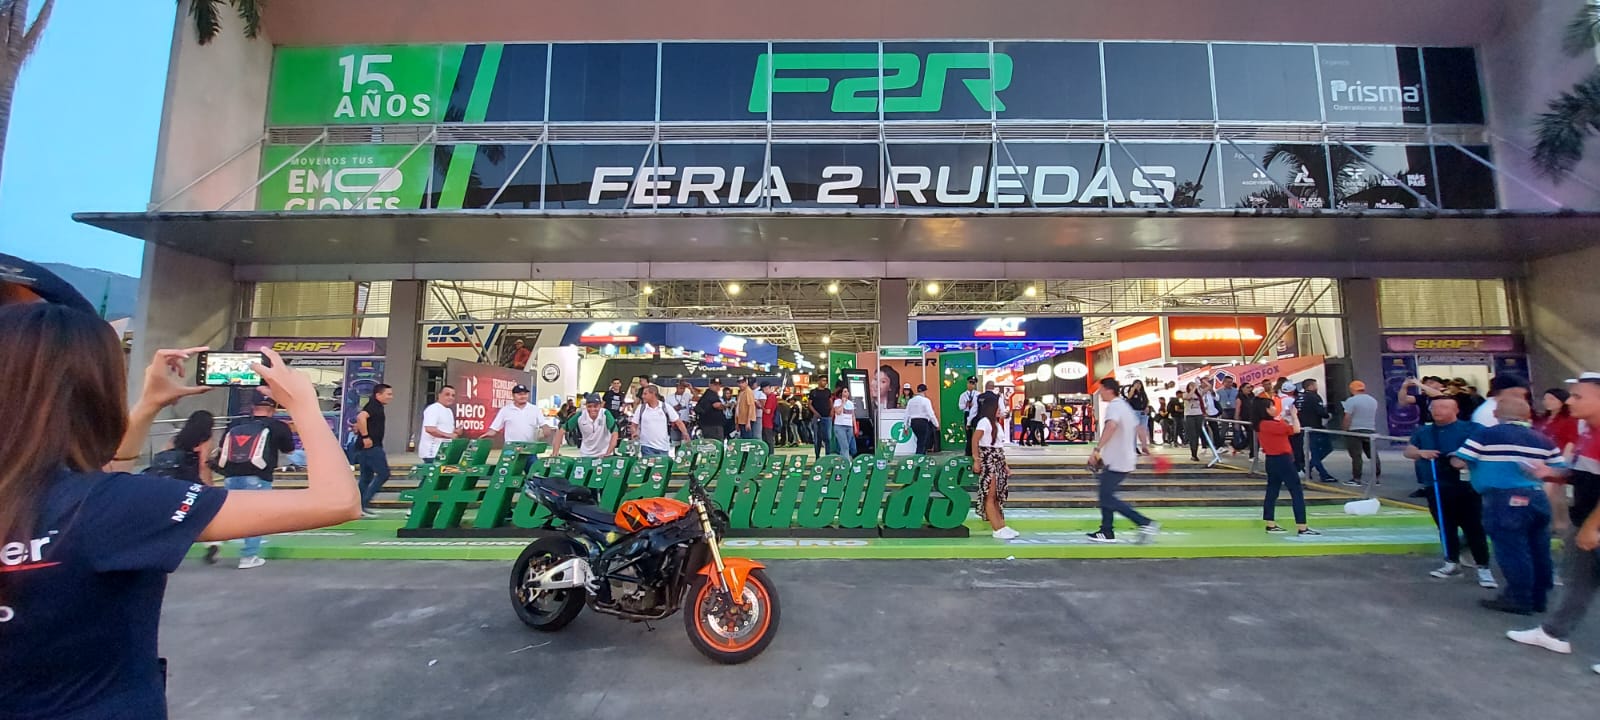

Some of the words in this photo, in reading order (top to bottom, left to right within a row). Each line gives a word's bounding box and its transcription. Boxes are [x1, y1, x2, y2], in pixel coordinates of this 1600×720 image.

[339, 54, 394, 92] 15
[748, 53, 1013, 112] F2R
[1330, 80, 1418, 103] Prisma
[334, 89, 431, 117] AÑOS
[290, 157, 346, 165] MOVEMOS
[352, 156, 374, 164] TUS
[588, 166, 792, 204] FERIA
[816, 166, 863, 203] 2
[884, 166, 1176, 204] RUEDAS
[271, 342, 346, 352] SHAFT
[1415, 339, 1484, 349] SHAFT
[1262, 365, 1280, 377] FOX
[456, 403, 486, 418] Hero
[456, 419, 484, 430] MOTOS
[171, 491, 198, 522] Mobil
